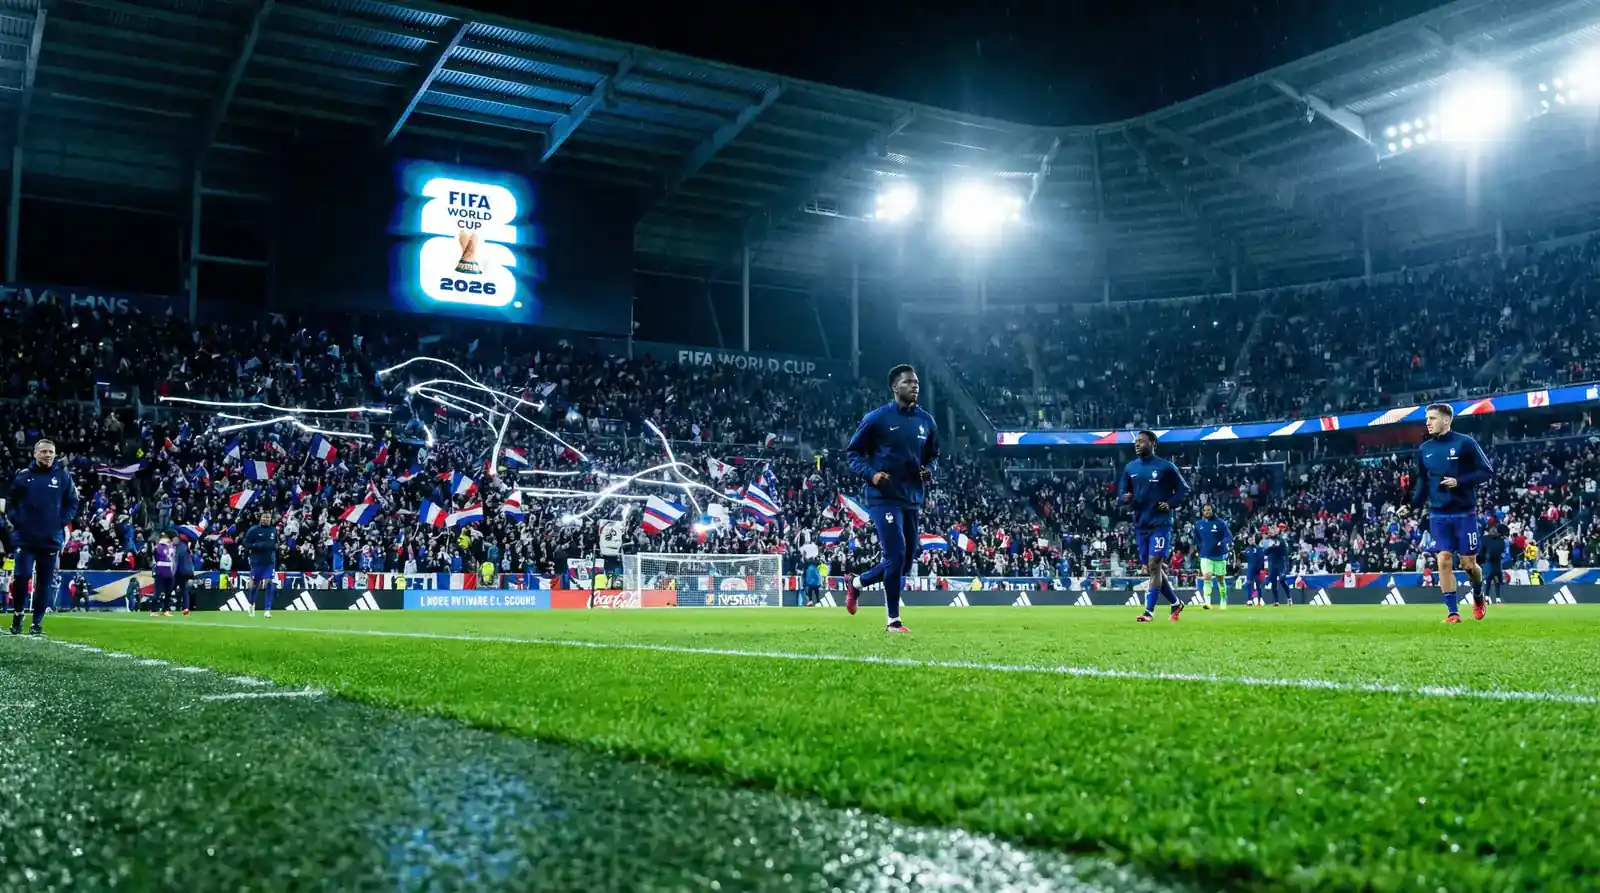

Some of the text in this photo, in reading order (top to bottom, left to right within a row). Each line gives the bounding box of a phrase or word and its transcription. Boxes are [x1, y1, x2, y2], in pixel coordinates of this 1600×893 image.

[449, 191, 491, 209] FIFA
[447, 208, 492, 221] WORLD
[457, 219, 482, 230] CUP
[440, 278, 497, 295] 2026
[678, 350, 816, 375] FIFA WORLD CUP
[1467, 532, 1478, 546] 18
